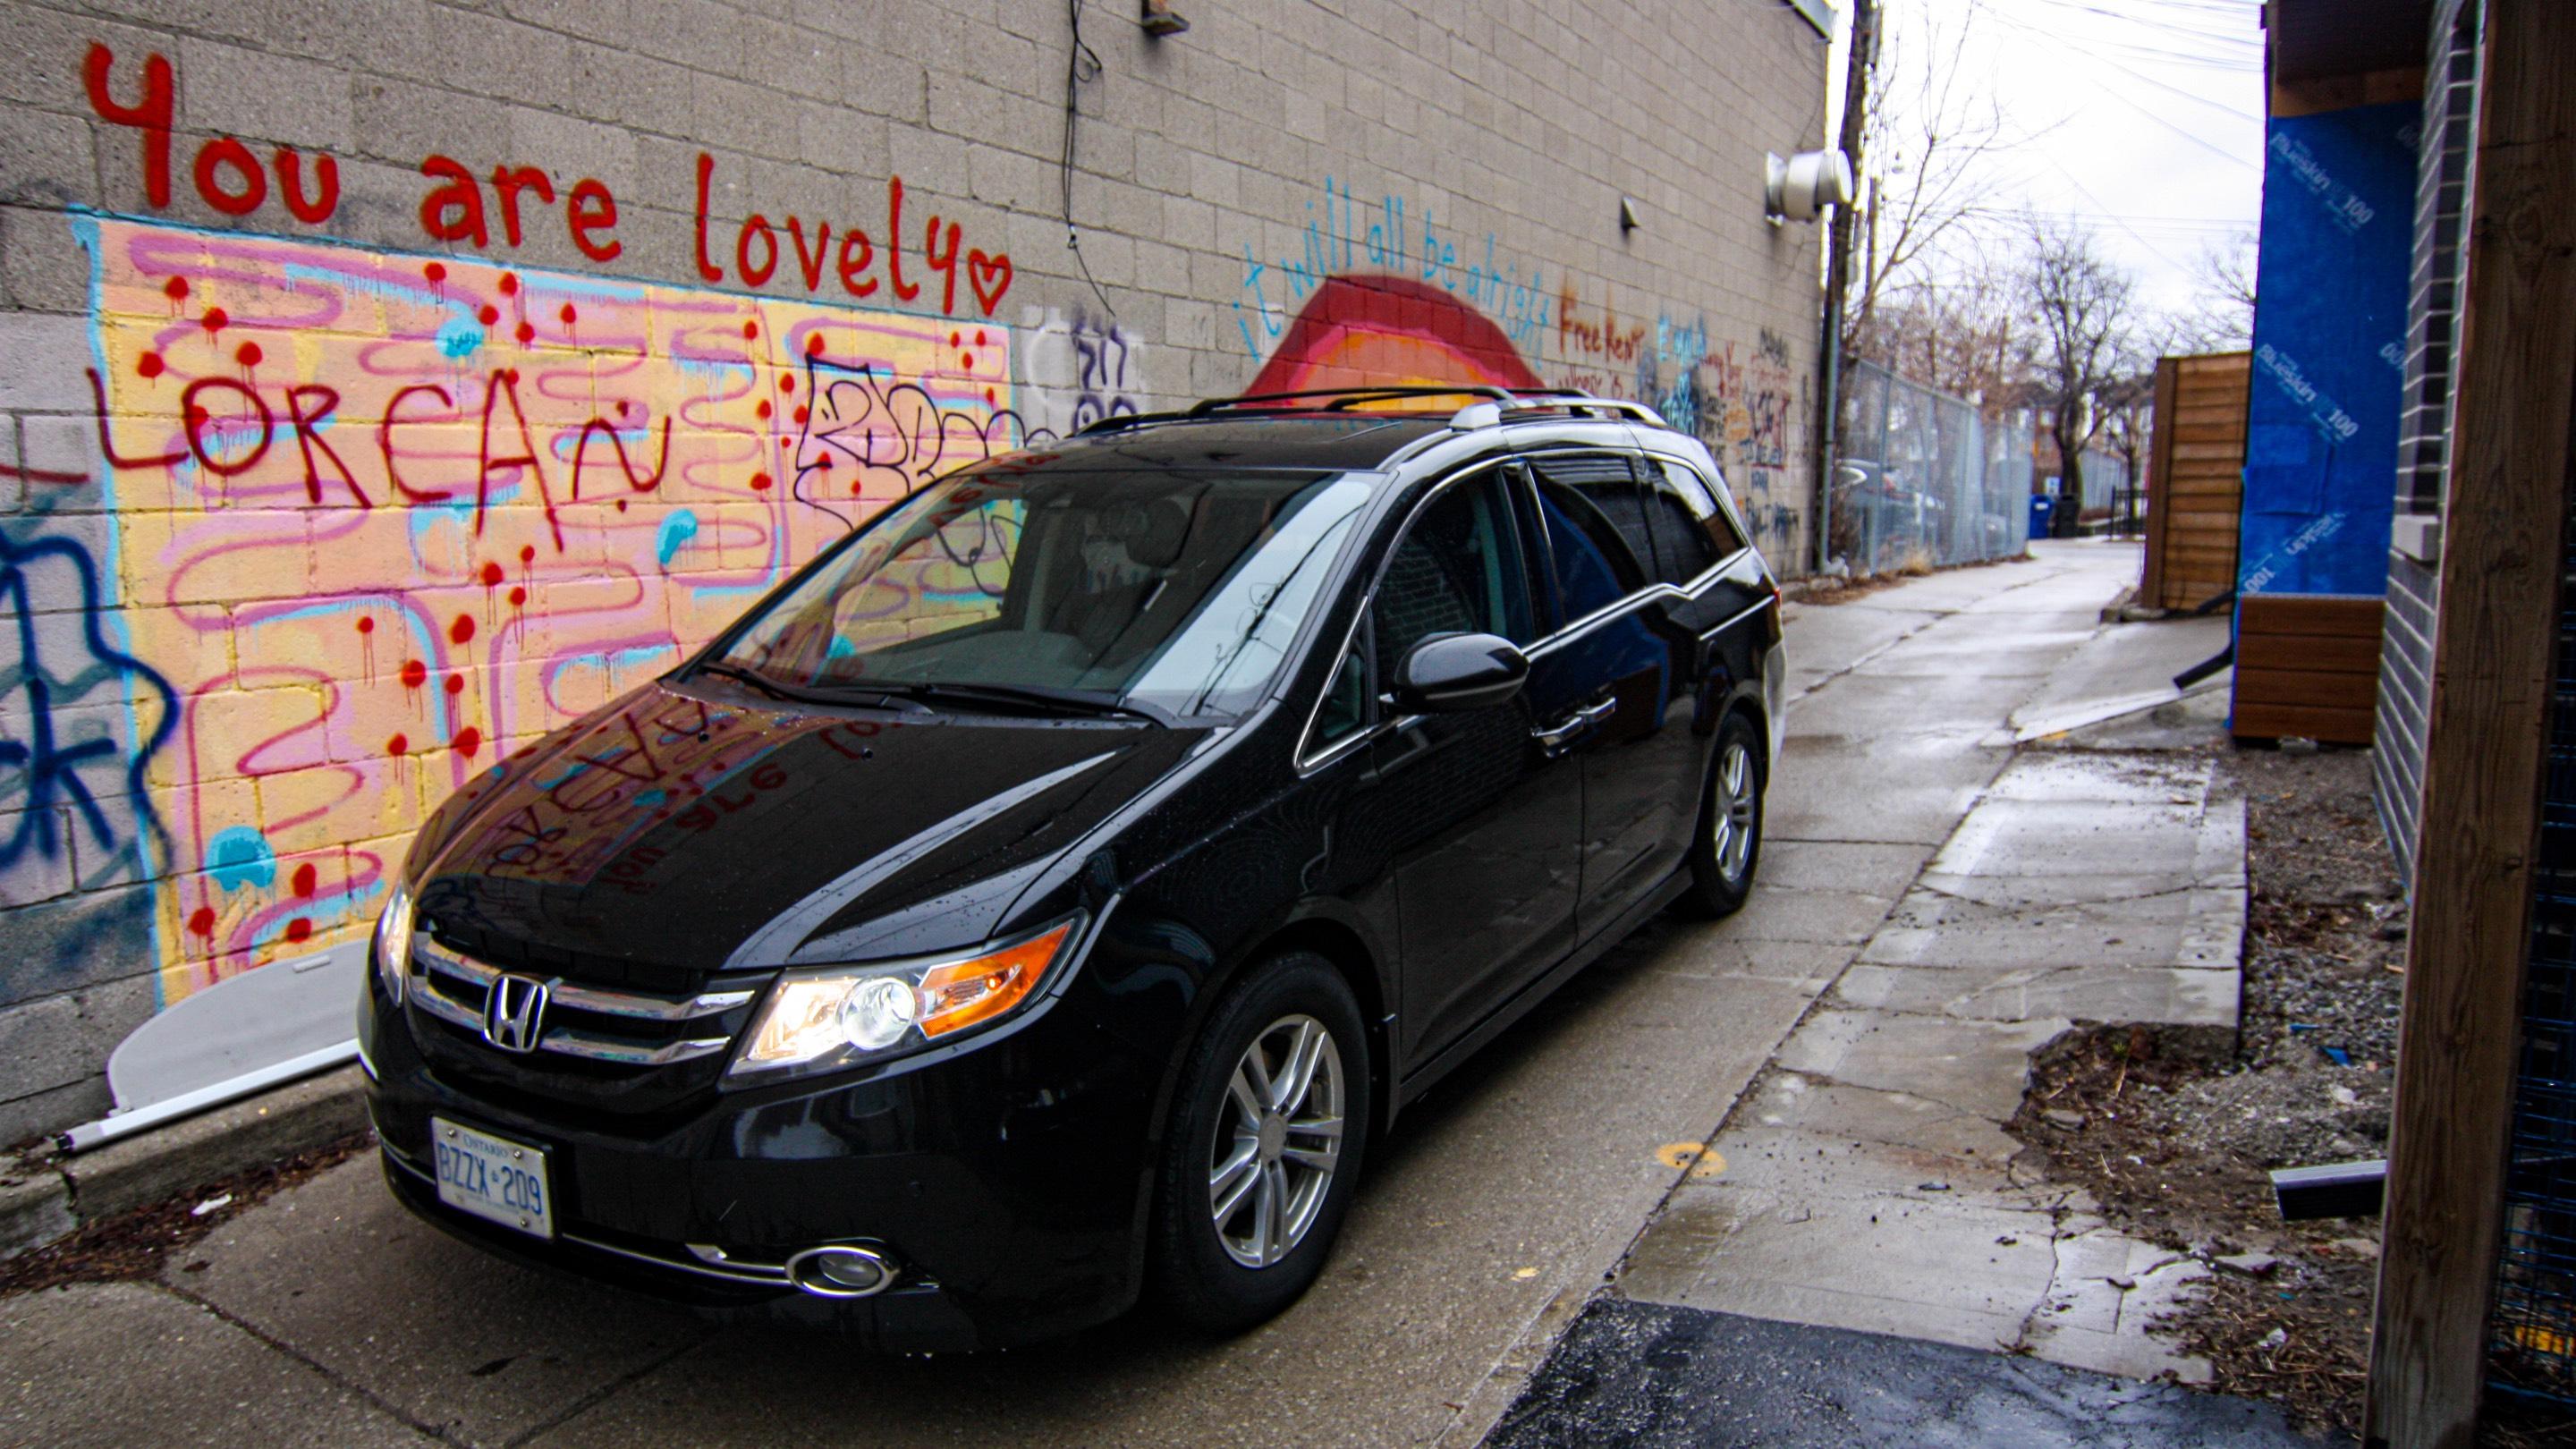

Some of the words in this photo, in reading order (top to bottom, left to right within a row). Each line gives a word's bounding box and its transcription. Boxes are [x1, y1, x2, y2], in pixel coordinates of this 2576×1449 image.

[420, 155, 622, 262] are
[695, 151, 962, 315] lovely
[1232, 242, 1282, 363] it
[1280, 174, 1352, 299] will
[1365, 194, 1405, 273] all
[1423, 208, 1457, 291] be
[2343, 194, 2375, 225] 100
[2257, 343, 2318, 402] Blueskin
[2328, 408, 2360, 437] 100
